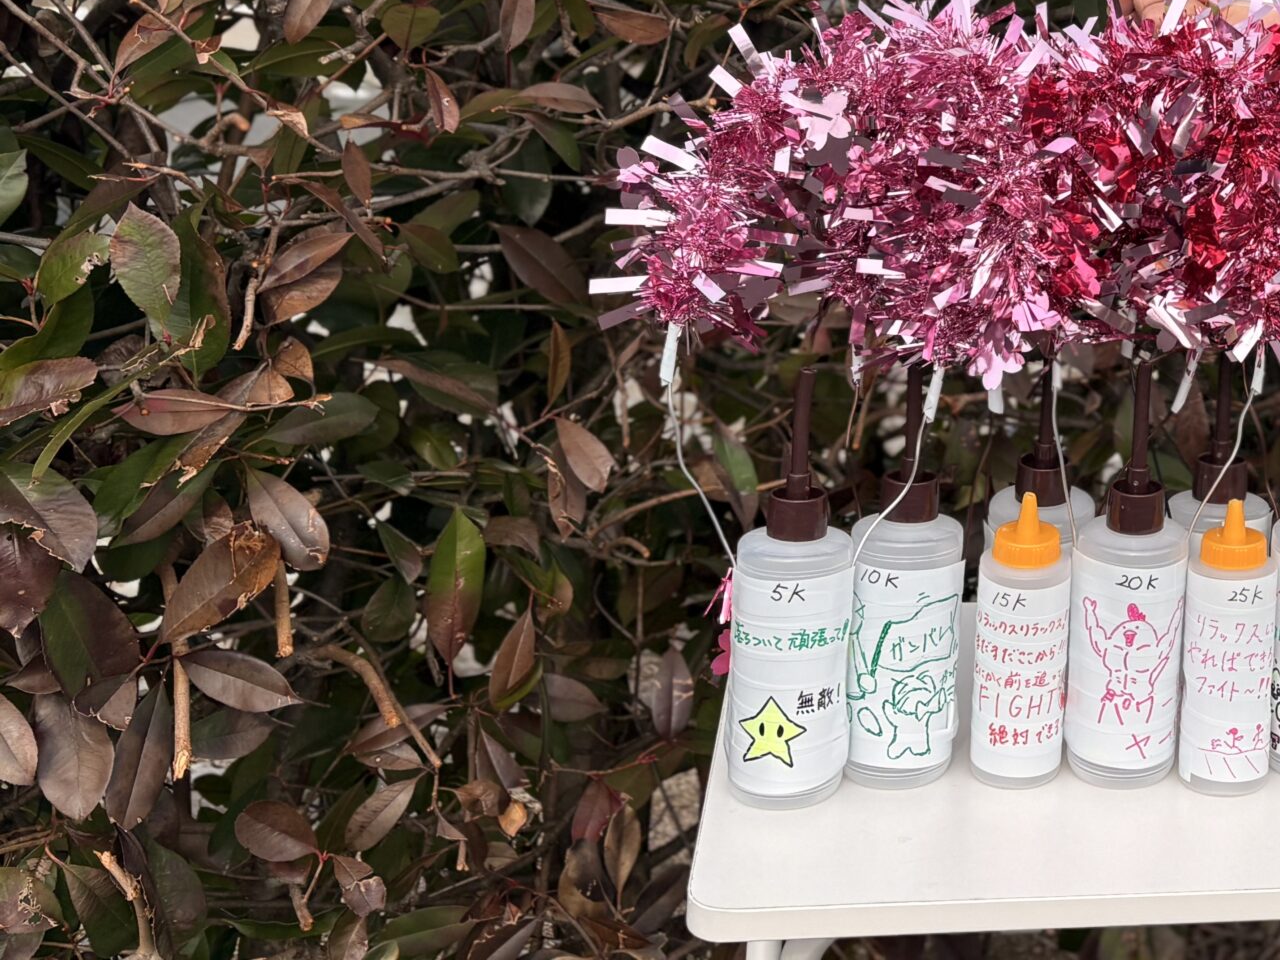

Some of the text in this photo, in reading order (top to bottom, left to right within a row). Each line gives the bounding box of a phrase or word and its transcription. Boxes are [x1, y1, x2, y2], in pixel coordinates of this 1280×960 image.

[860, 569, 899, 589] 10K
[1115, 574, 1159, 590] 20K
[770, 583, 806, 603] 5K
[992, 592, 1027, 611] 15K
[1227, 585, 1264, 605] 25K
[979, 683, 1058, 719] FIGHT
